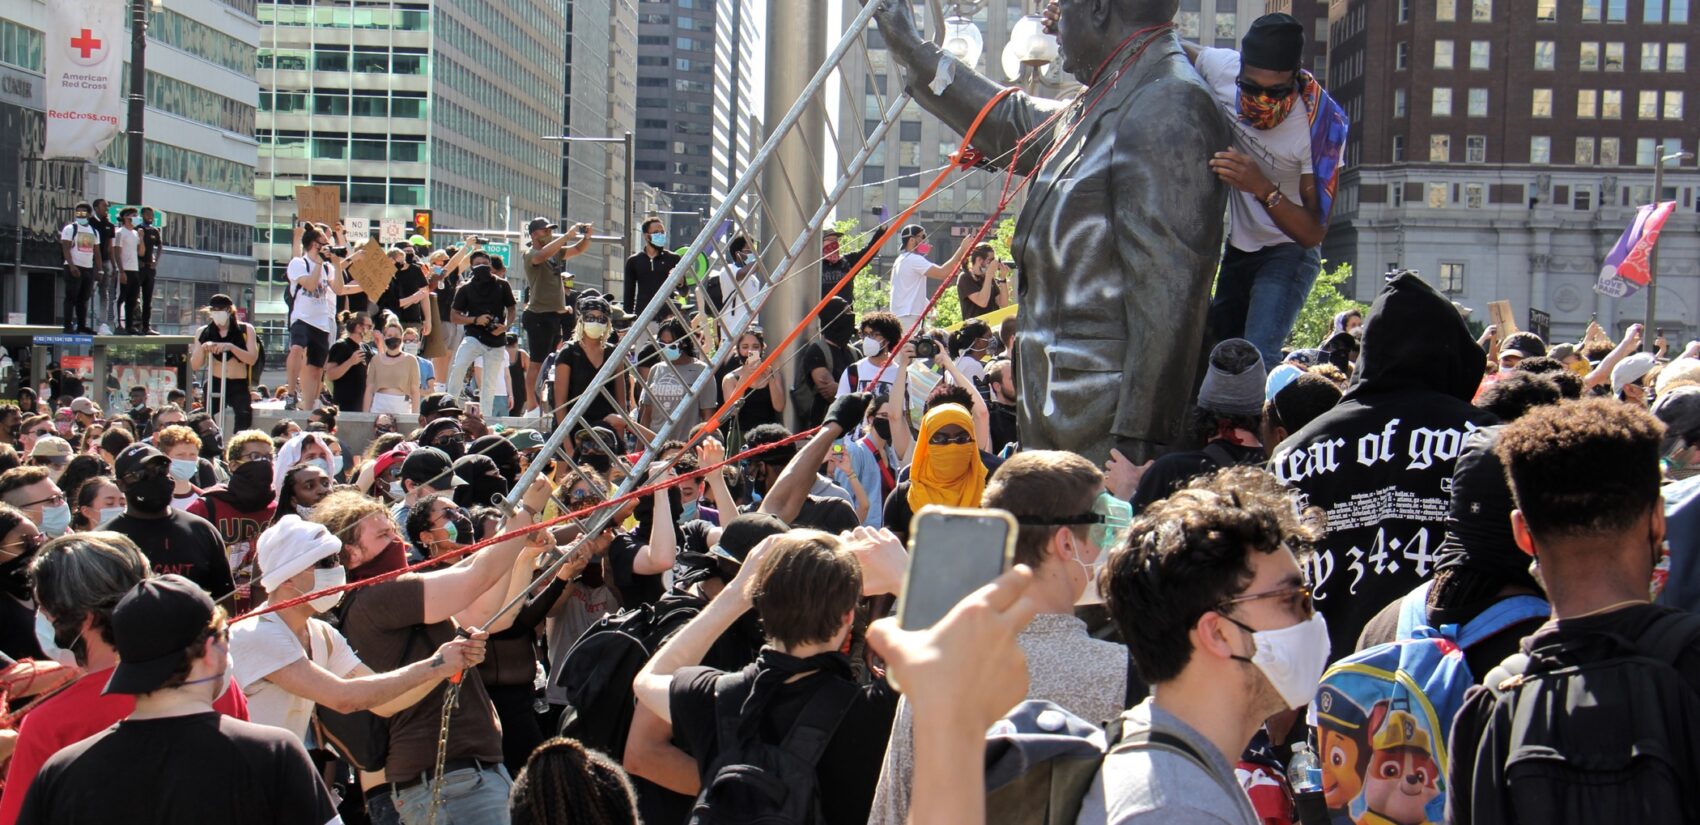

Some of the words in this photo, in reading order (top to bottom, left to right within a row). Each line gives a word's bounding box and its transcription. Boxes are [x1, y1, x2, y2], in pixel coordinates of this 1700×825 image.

[62, 73, 108, 82] American
[62, 80, 79, 88] Red
[81, 81, 107, 90] Cross
[48, 109, 117, 125] RedCross.org
[1600, 278, 1622, 288] LOVE
[1599, 285, 1621, 295] PARK
[1357, 418, 1400, 467] of
